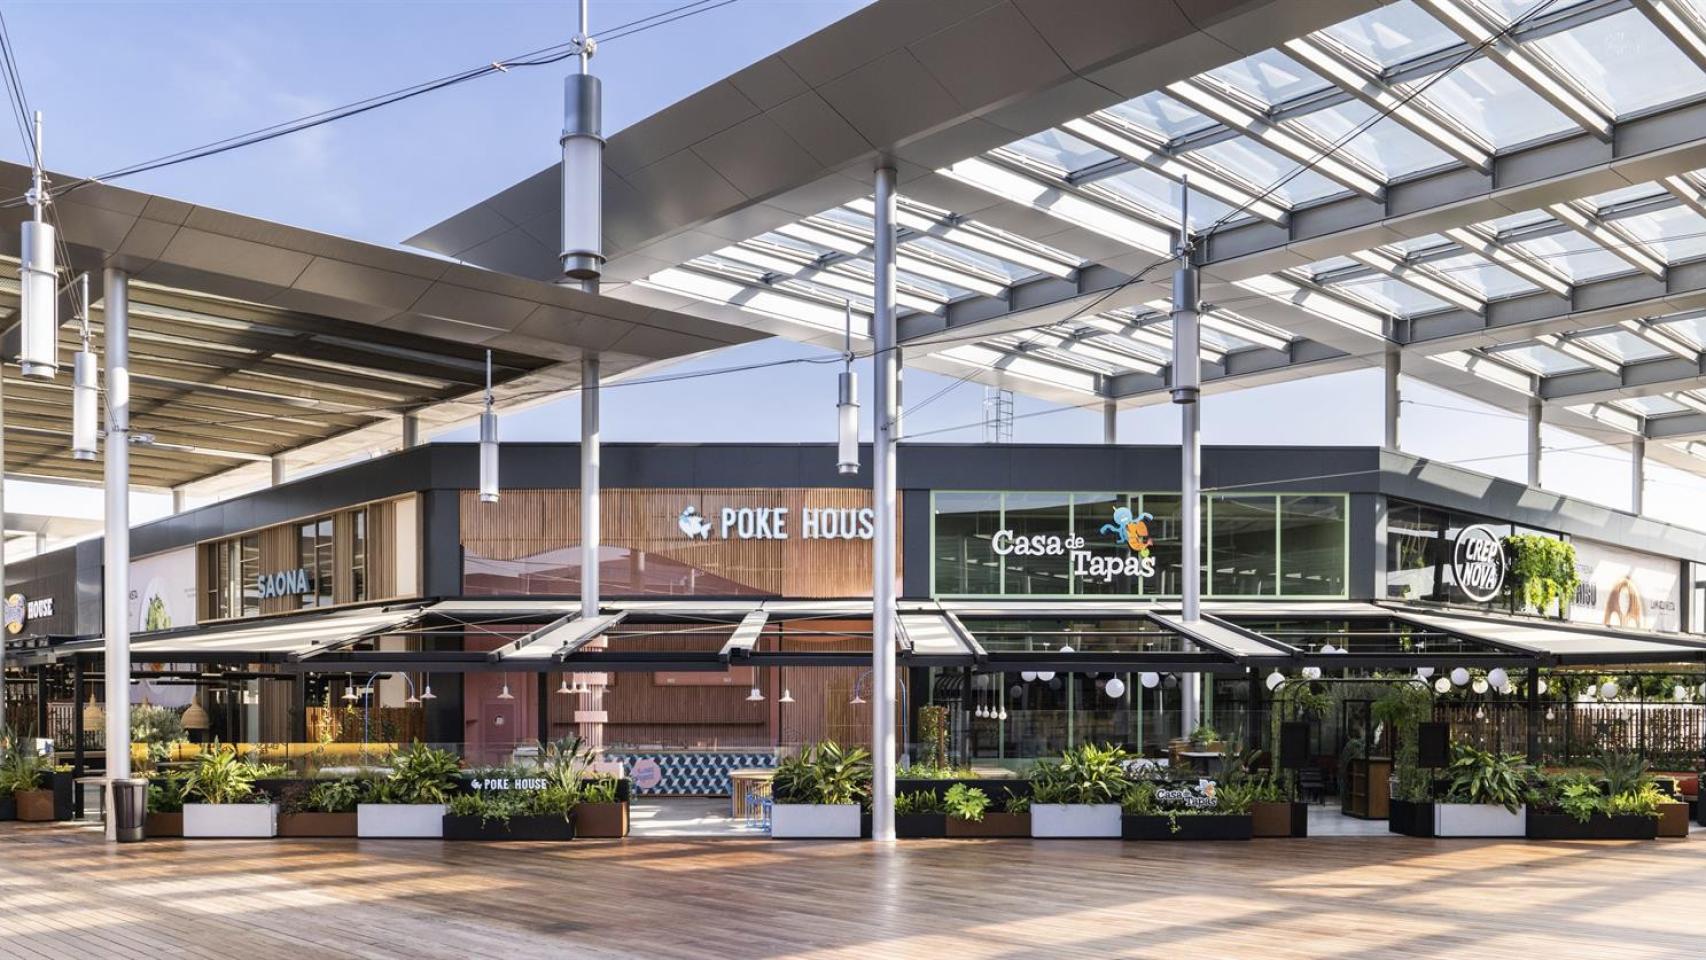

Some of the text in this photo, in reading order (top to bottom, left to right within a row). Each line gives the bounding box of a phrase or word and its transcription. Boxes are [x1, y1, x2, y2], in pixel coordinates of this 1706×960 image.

[721, 507, 875, 540] POKE HOUS
[991, 529, 1085, 556] Casa de
[1466, 538, 1498, 562] CREP
[1072, 550, 1156, 582] Tapas
[1462, 561, 1498, 590] NOVA
[257, 568, 310, 599] SAONA
[27, 597, 54, 620] HOUSE
[484, 778, 547, 790] POKE HOUSE
